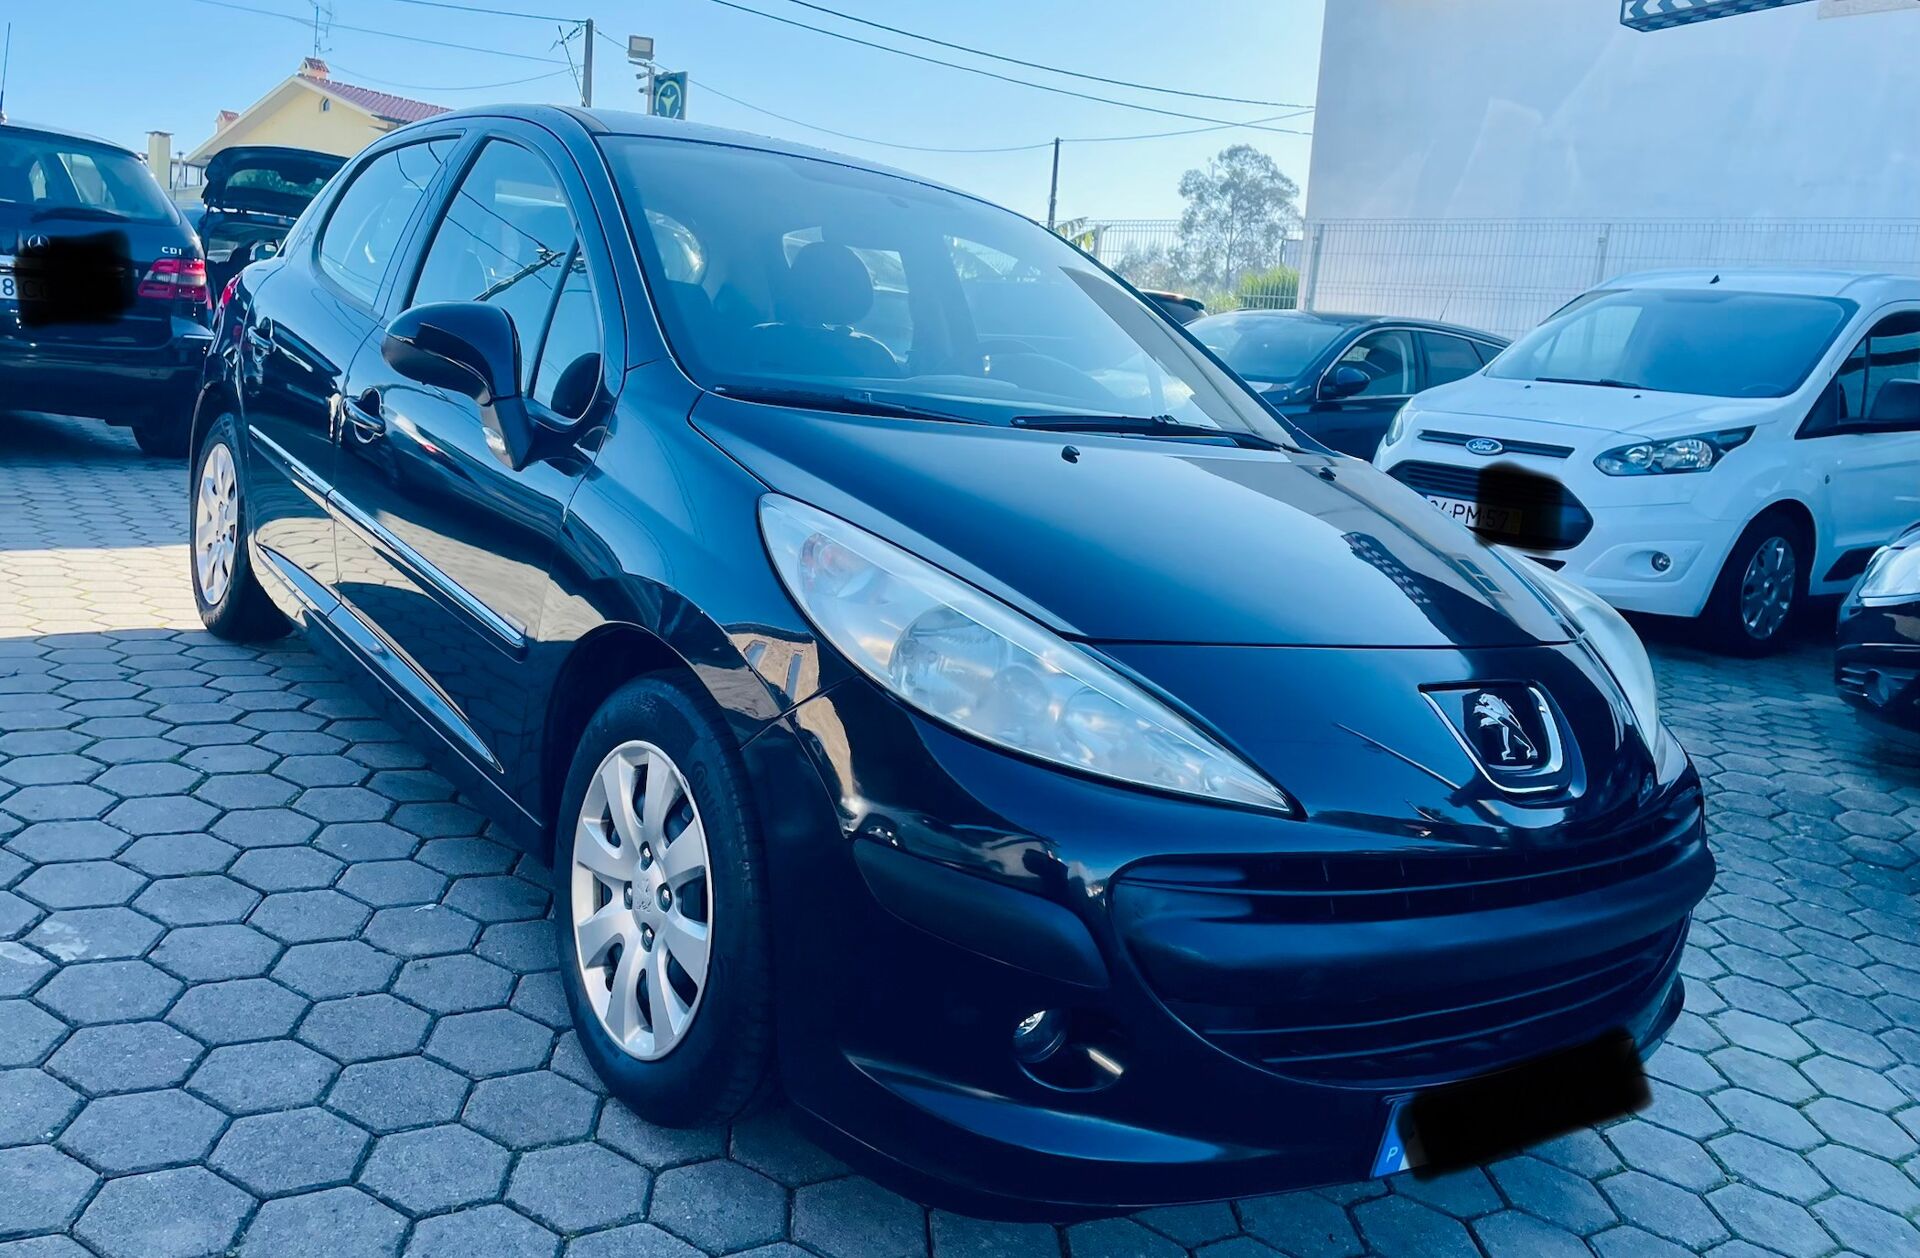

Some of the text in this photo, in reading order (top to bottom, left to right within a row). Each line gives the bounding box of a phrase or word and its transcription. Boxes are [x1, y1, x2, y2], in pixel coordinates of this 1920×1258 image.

[161, 246, 182, 256] CDI
[1471, 439, 1495, 451] Ford
[1385, 1145, 1399, 1164] P
